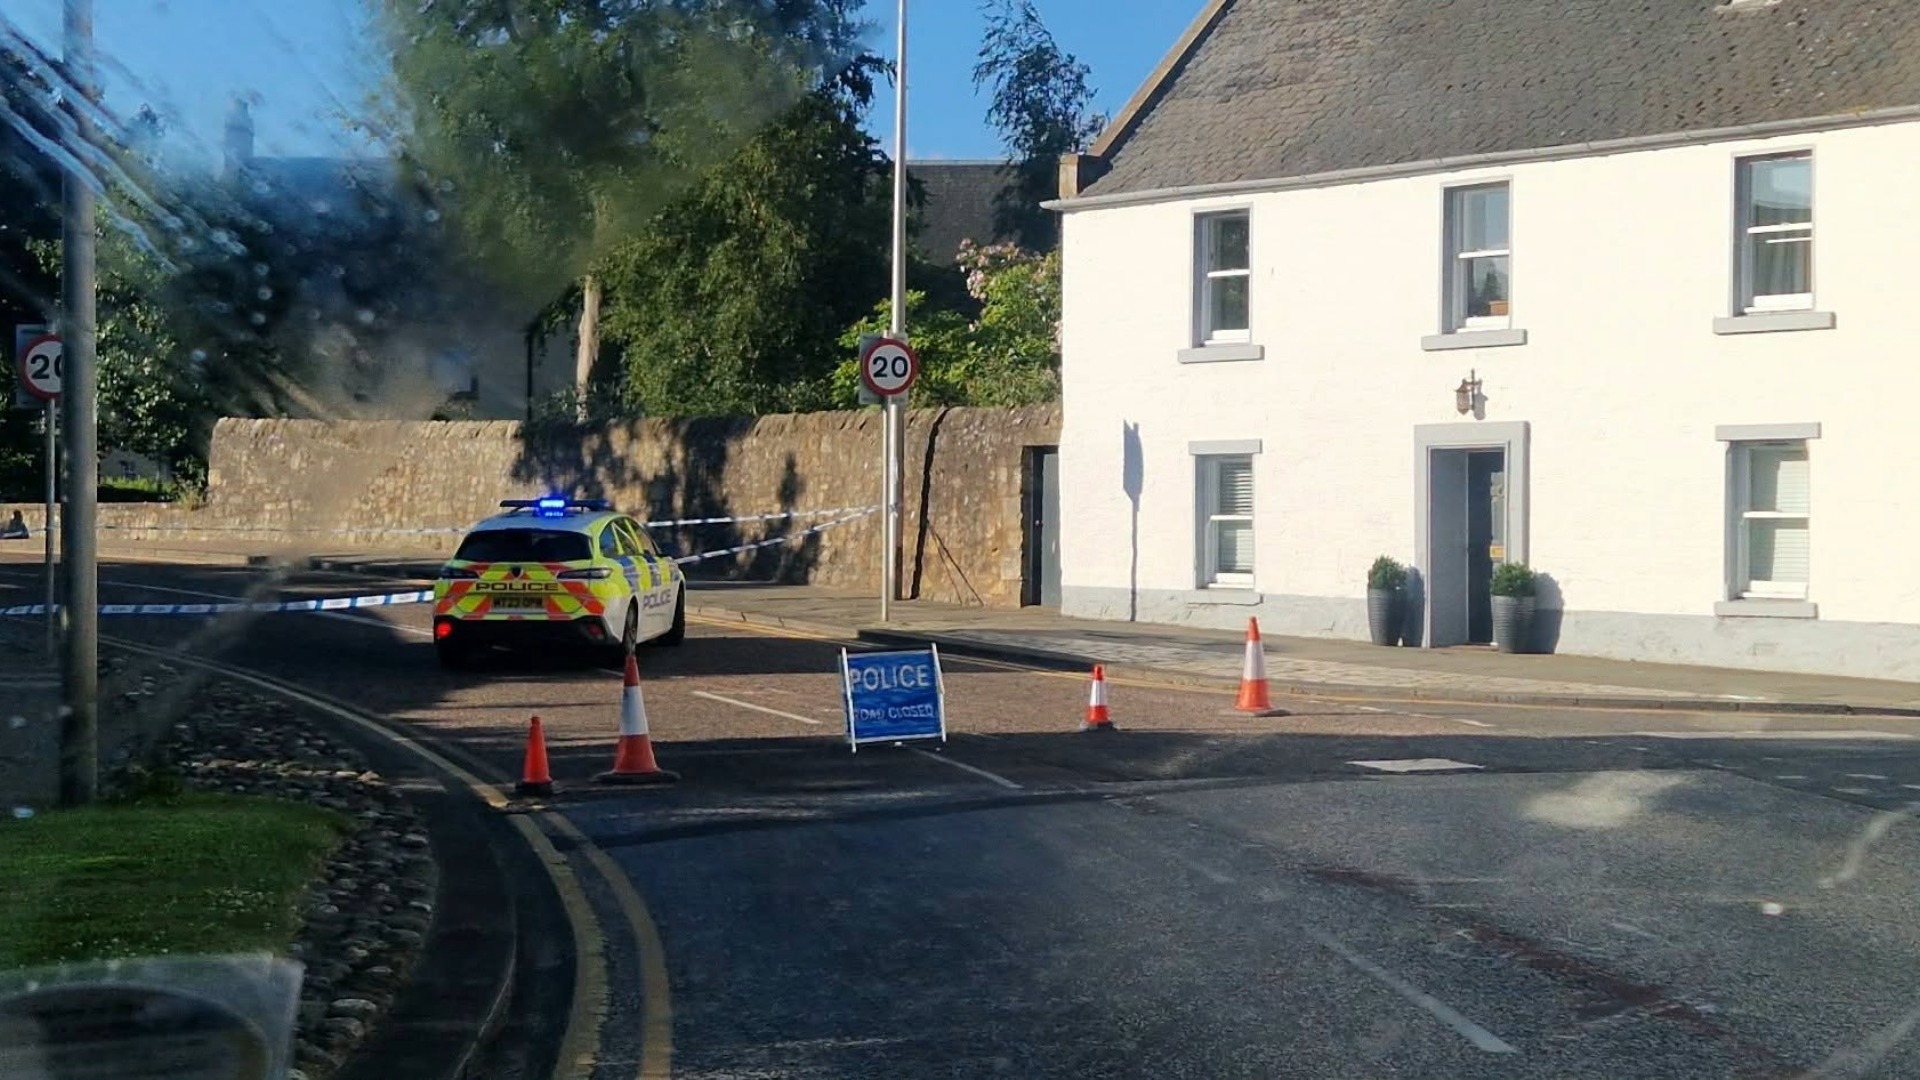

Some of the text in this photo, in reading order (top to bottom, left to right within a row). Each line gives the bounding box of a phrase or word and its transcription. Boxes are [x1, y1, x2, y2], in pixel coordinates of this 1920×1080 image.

[872, 355, 908, 378] 20
[475, 582, 559, 591] POLICE
[849, 664, 931, 692] POLICE
[888, 703, 935, 719] CLOSED
